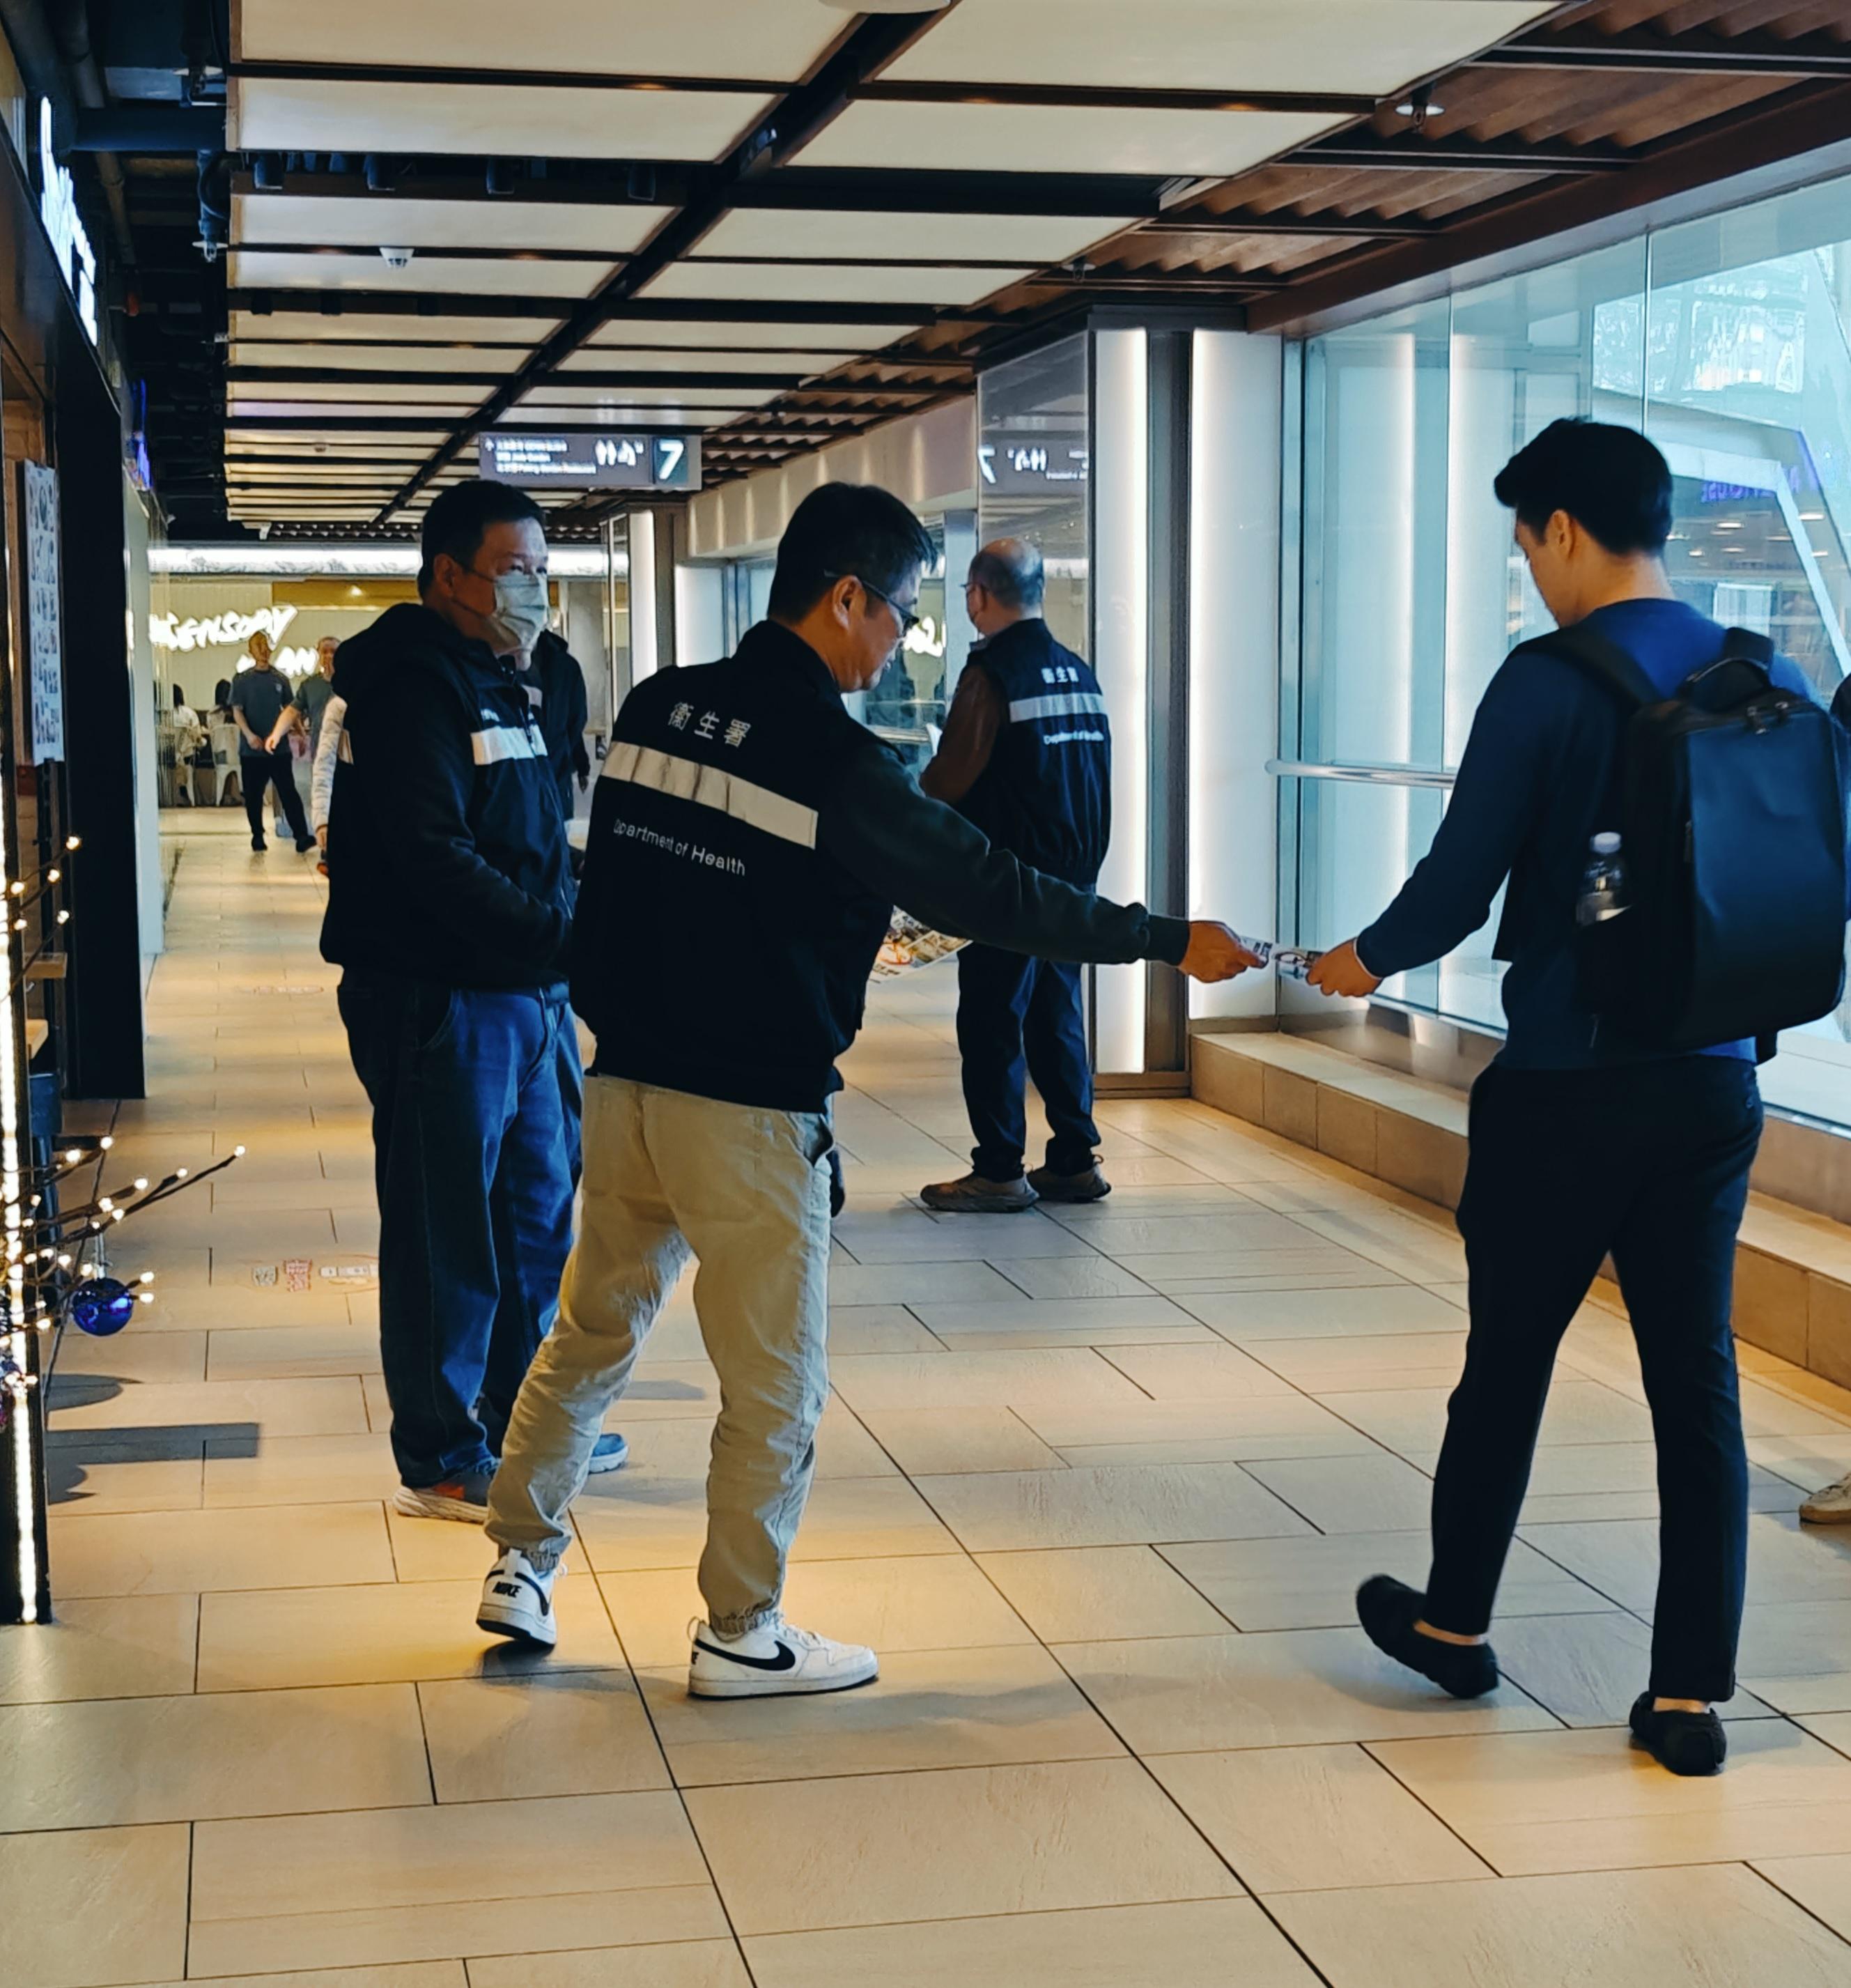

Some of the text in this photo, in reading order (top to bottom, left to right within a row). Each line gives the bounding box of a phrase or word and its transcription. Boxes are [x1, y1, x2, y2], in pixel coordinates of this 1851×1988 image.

[658, 439, 684, 480] 7
[667, 702, 752, 748] 衛生署
[674, 841, 690, 858] of
[691, 845, 746, 877] Health
